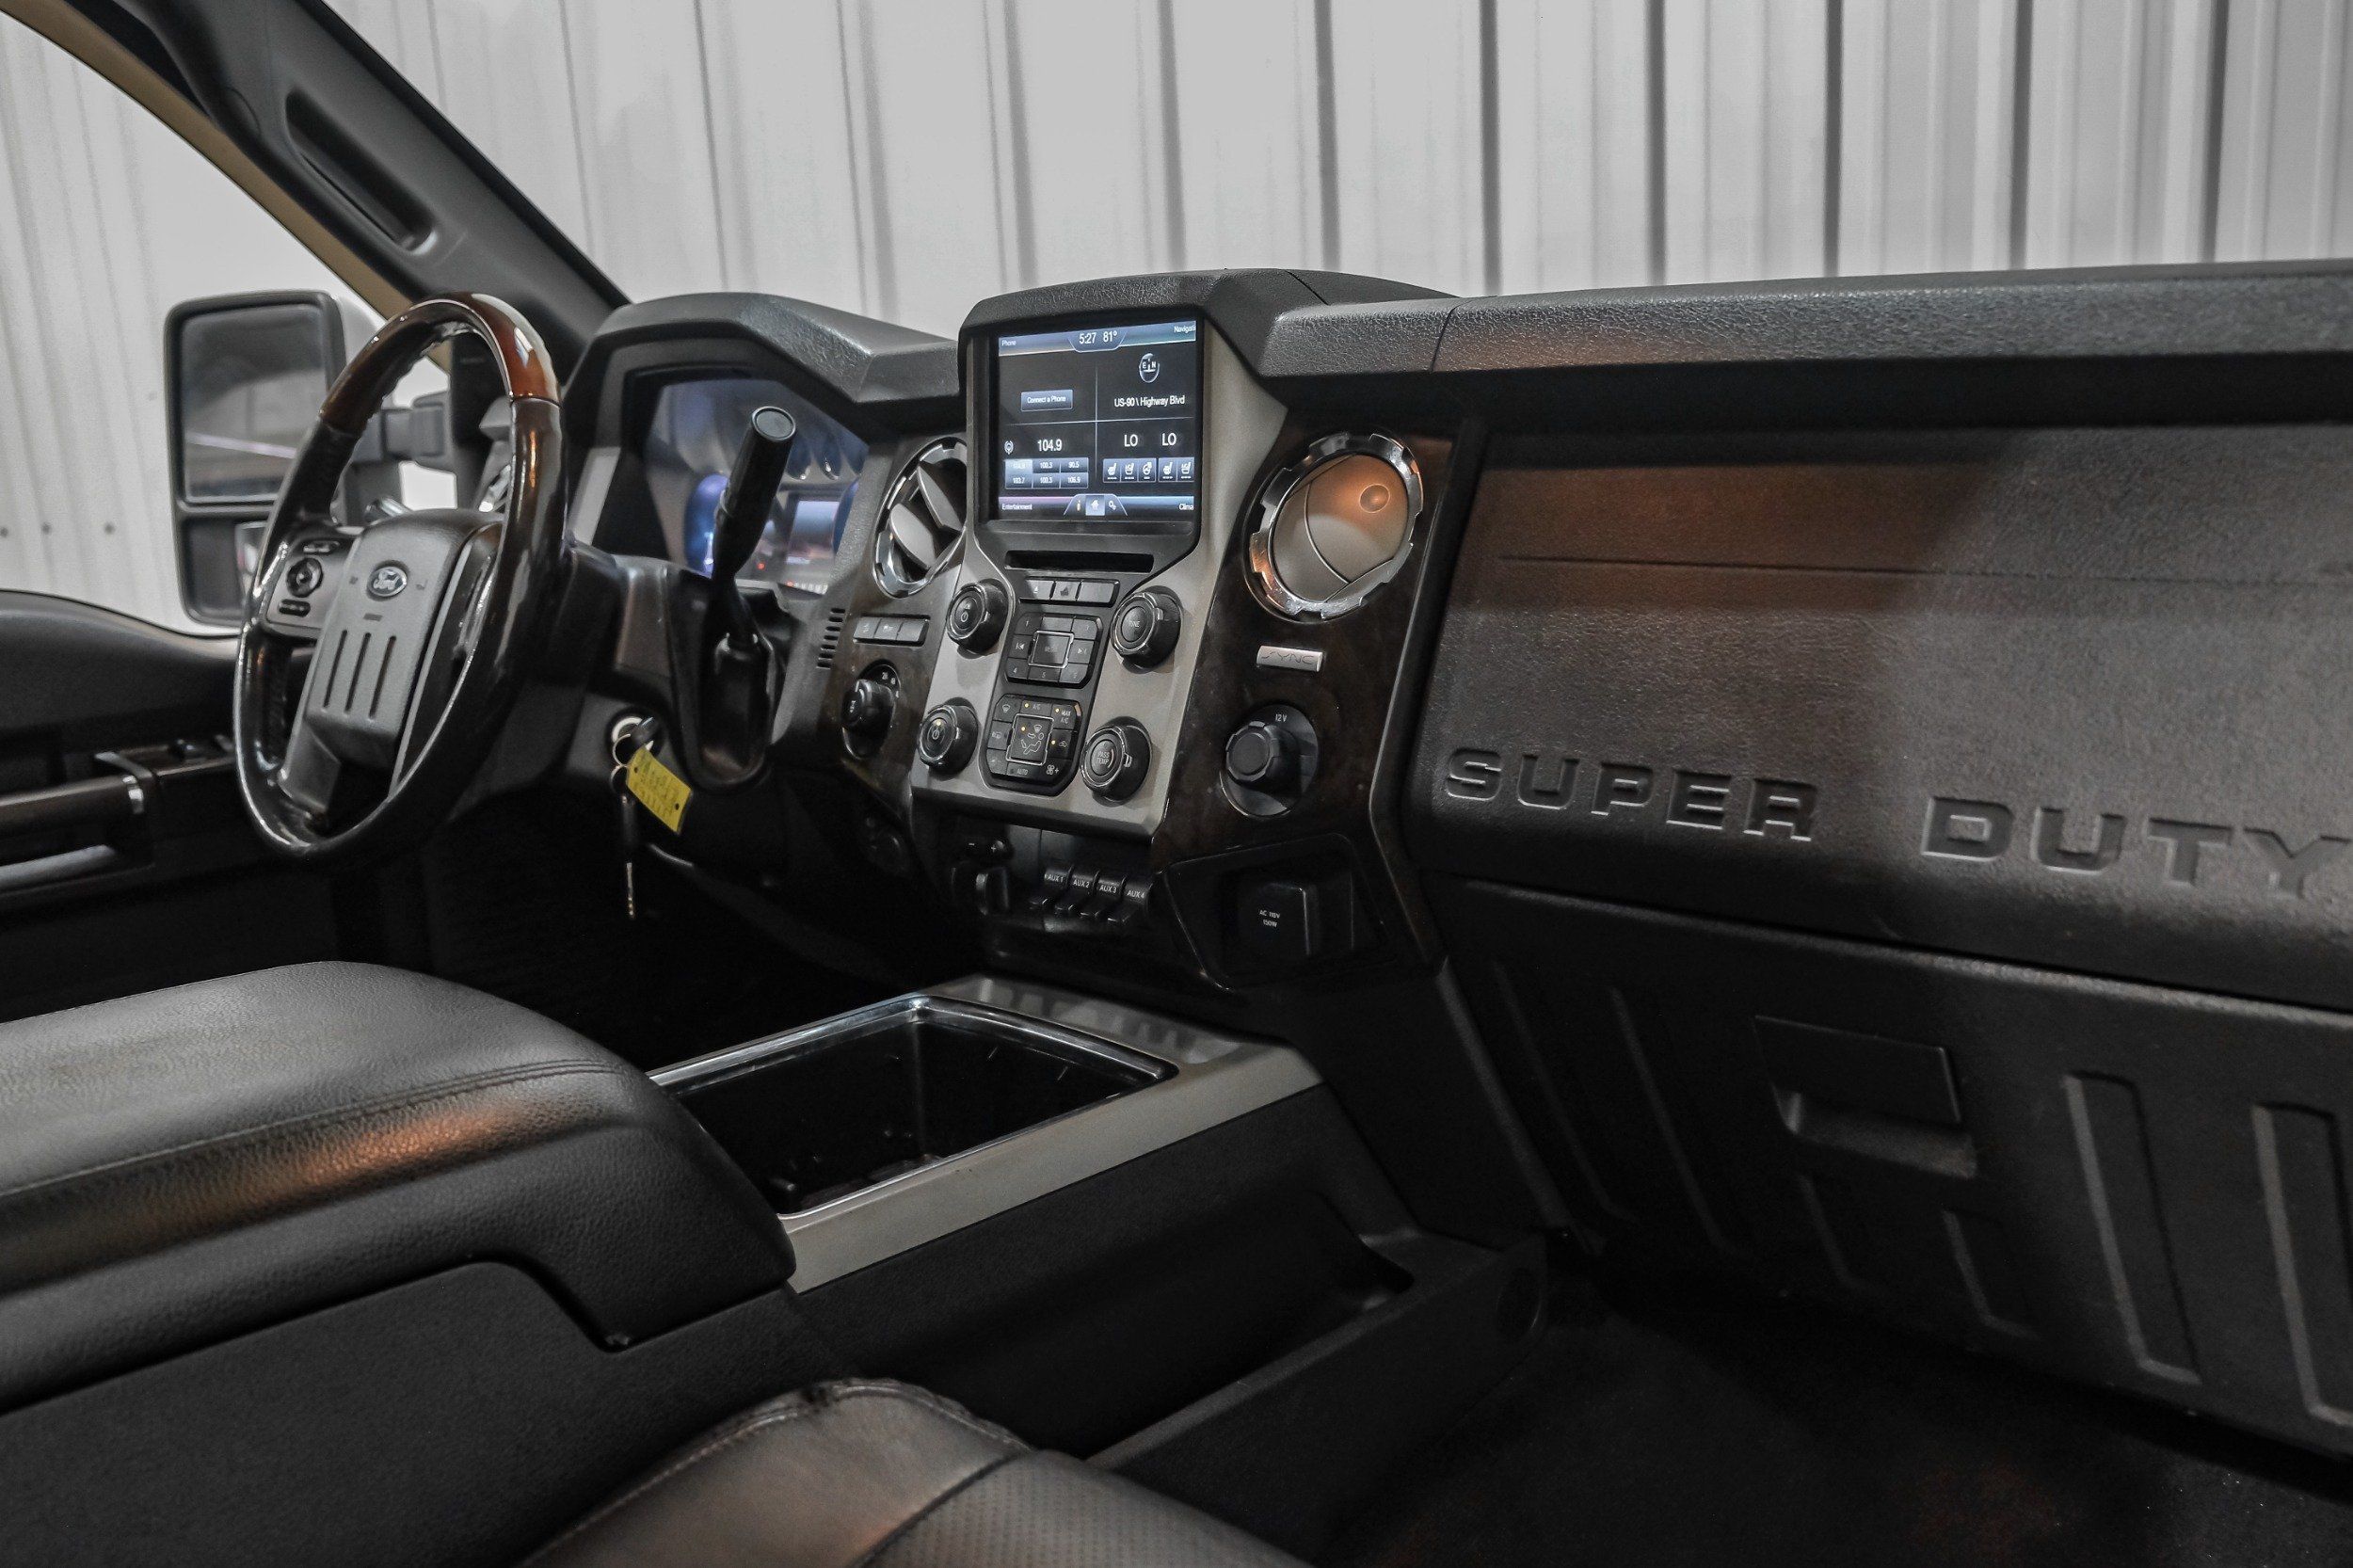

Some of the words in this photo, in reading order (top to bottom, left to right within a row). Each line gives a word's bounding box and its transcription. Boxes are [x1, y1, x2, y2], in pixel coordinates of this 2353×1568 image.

[1079, 332, 1096, 344] 5:27
[1050, 394, 1066, 403] Phone
[1113, 396, 1135, 408] US-90
[1140, 396, 1169, 408] Highway
[1169, 394, 1186, 405] Blvd
[1037, 439, 1063, 452] 104.9
[1124, 434, 1139, 447] LO
[1161, 432, 1177, 446] LO
[1261, 650, 1315, 665] SYNC
[1446, 747, 1817, 842] SUPER
[1920, 795, 2352, 900] DUTY
[1048, 873, 1059, 883] AUX
[1073, 879, 1086, 888] AUX
[1127, 889, 1140, 898] AUX
